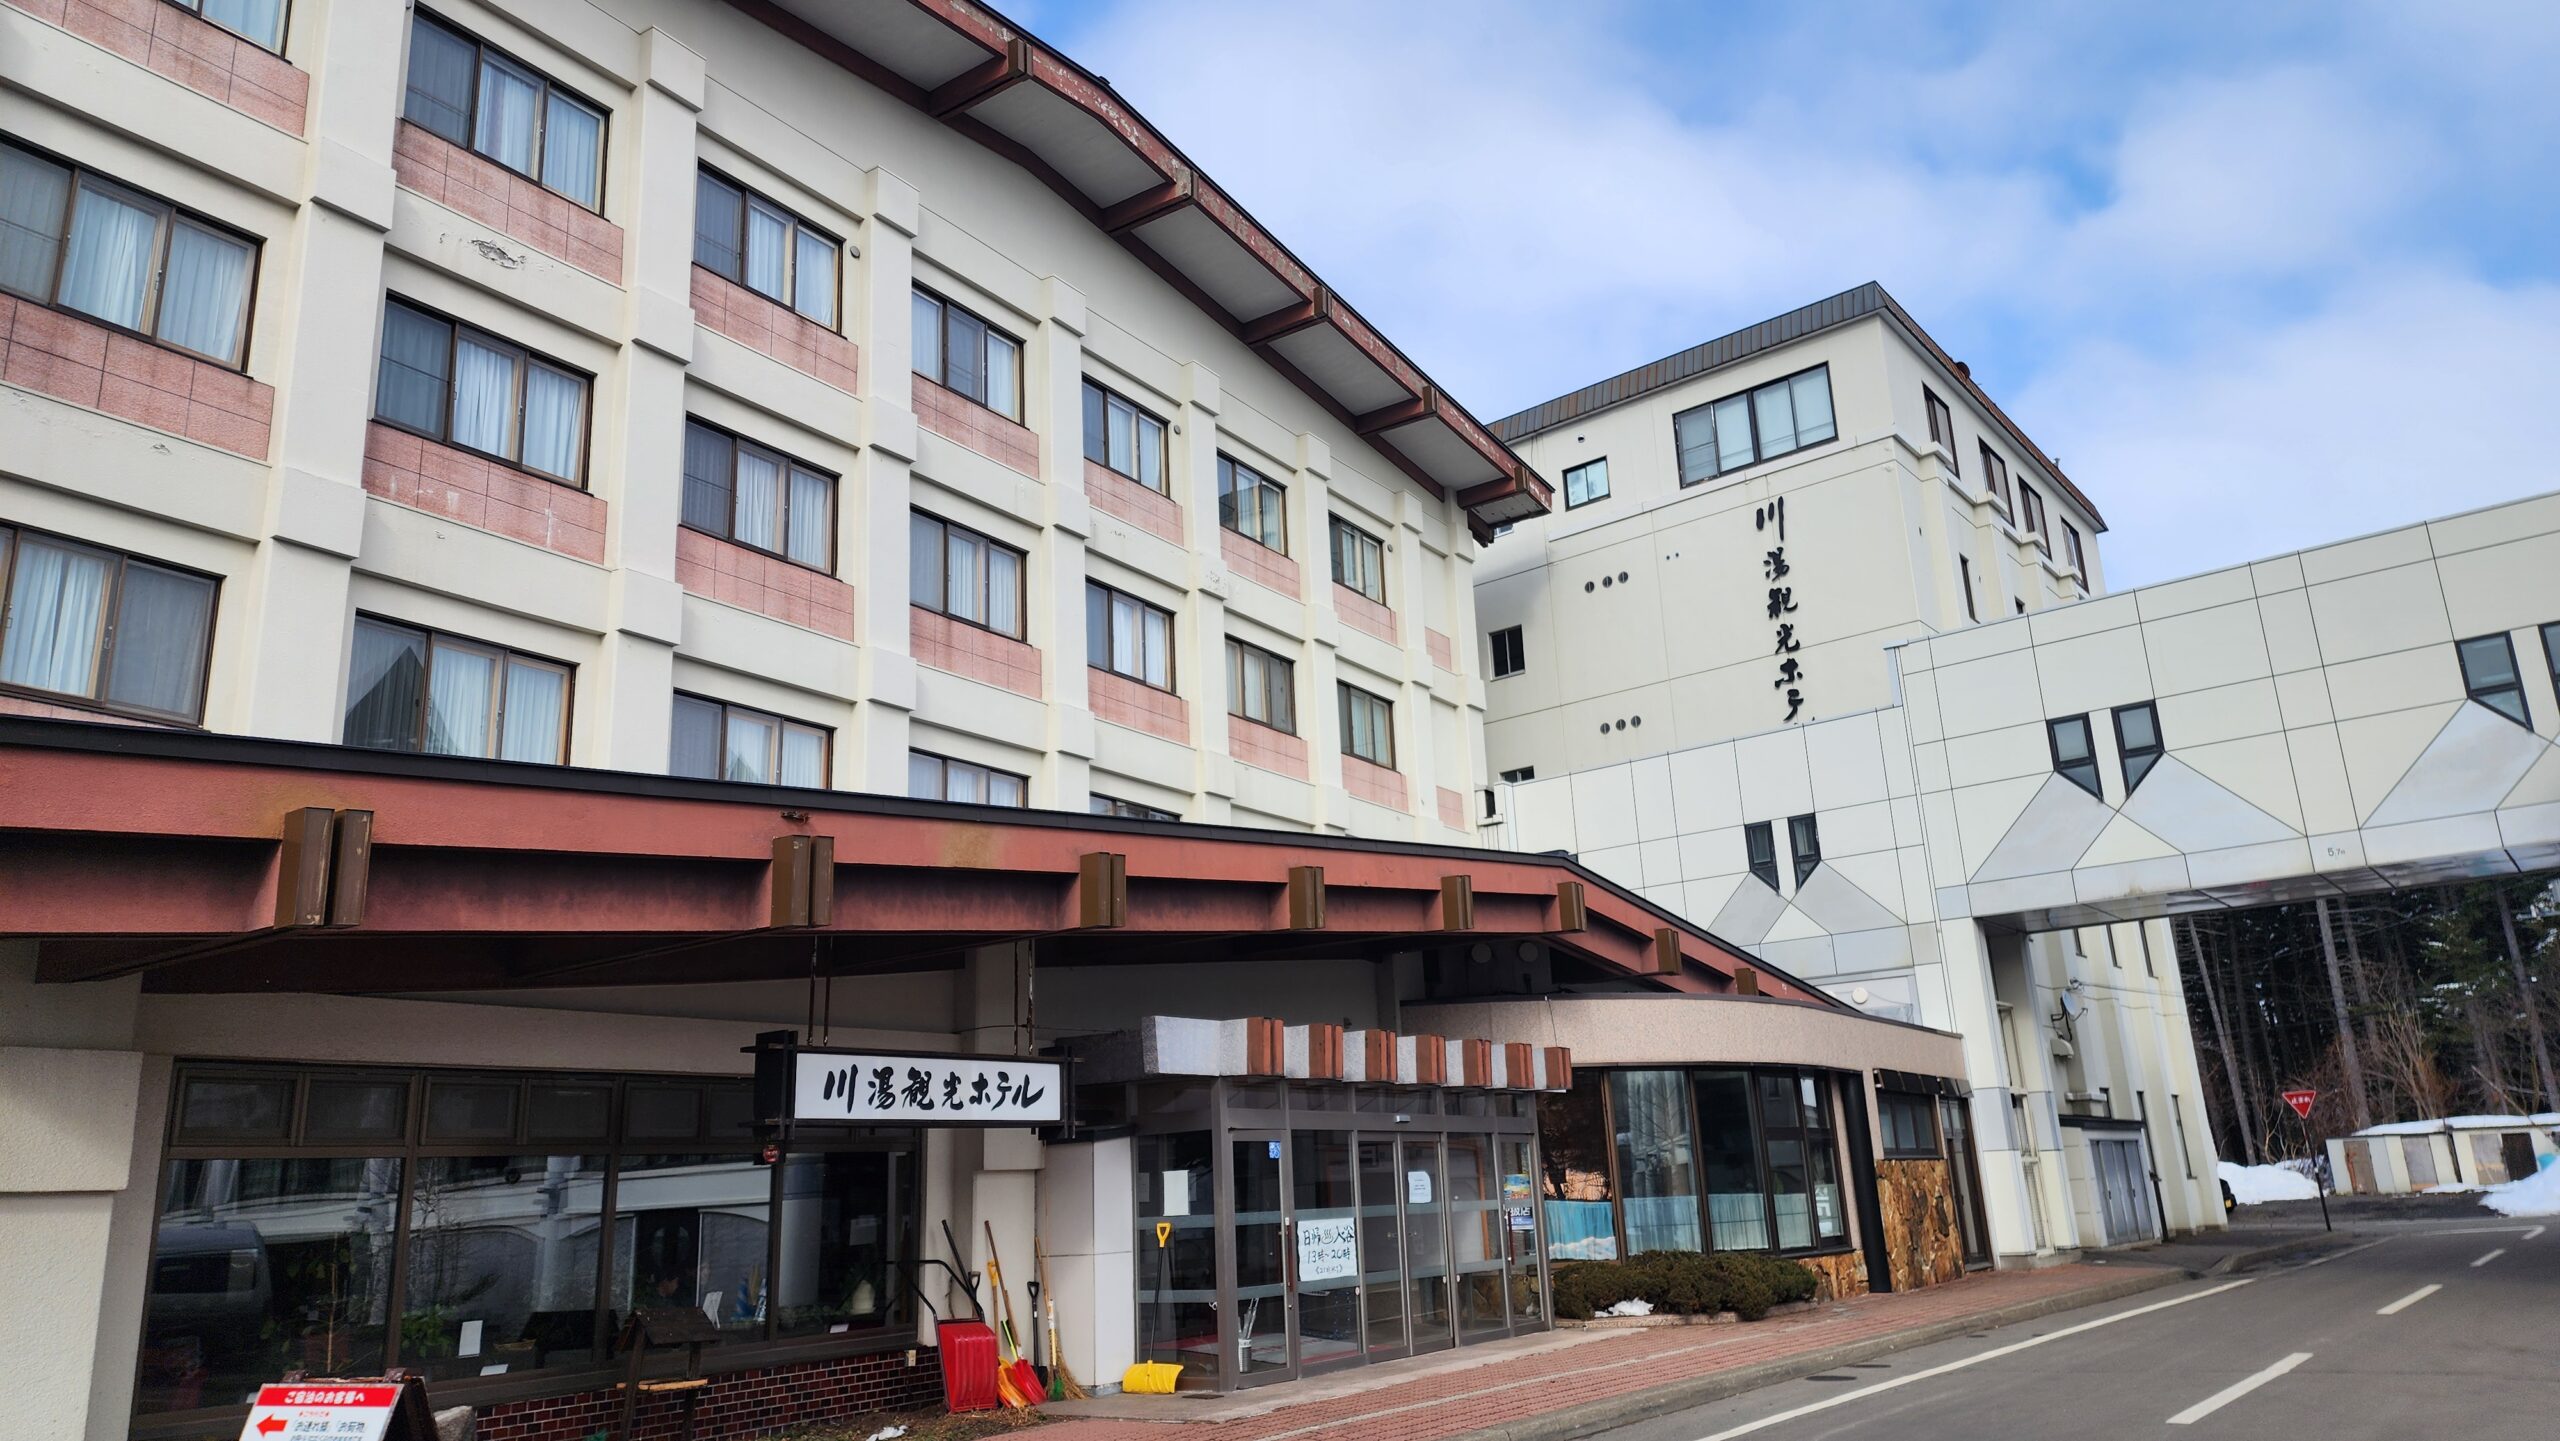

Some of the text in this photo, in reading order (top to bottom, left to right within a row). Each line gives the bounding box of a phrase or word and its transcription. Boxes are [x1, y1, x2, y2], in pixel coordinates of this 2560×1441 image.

[1756, 496, 1815, 725] 川湯観光ホテ
[823, 1063, 1045, 1114] 川湯観光ホテル
[284, 1390, 365, 1404] ご宿泊のお客様へ
